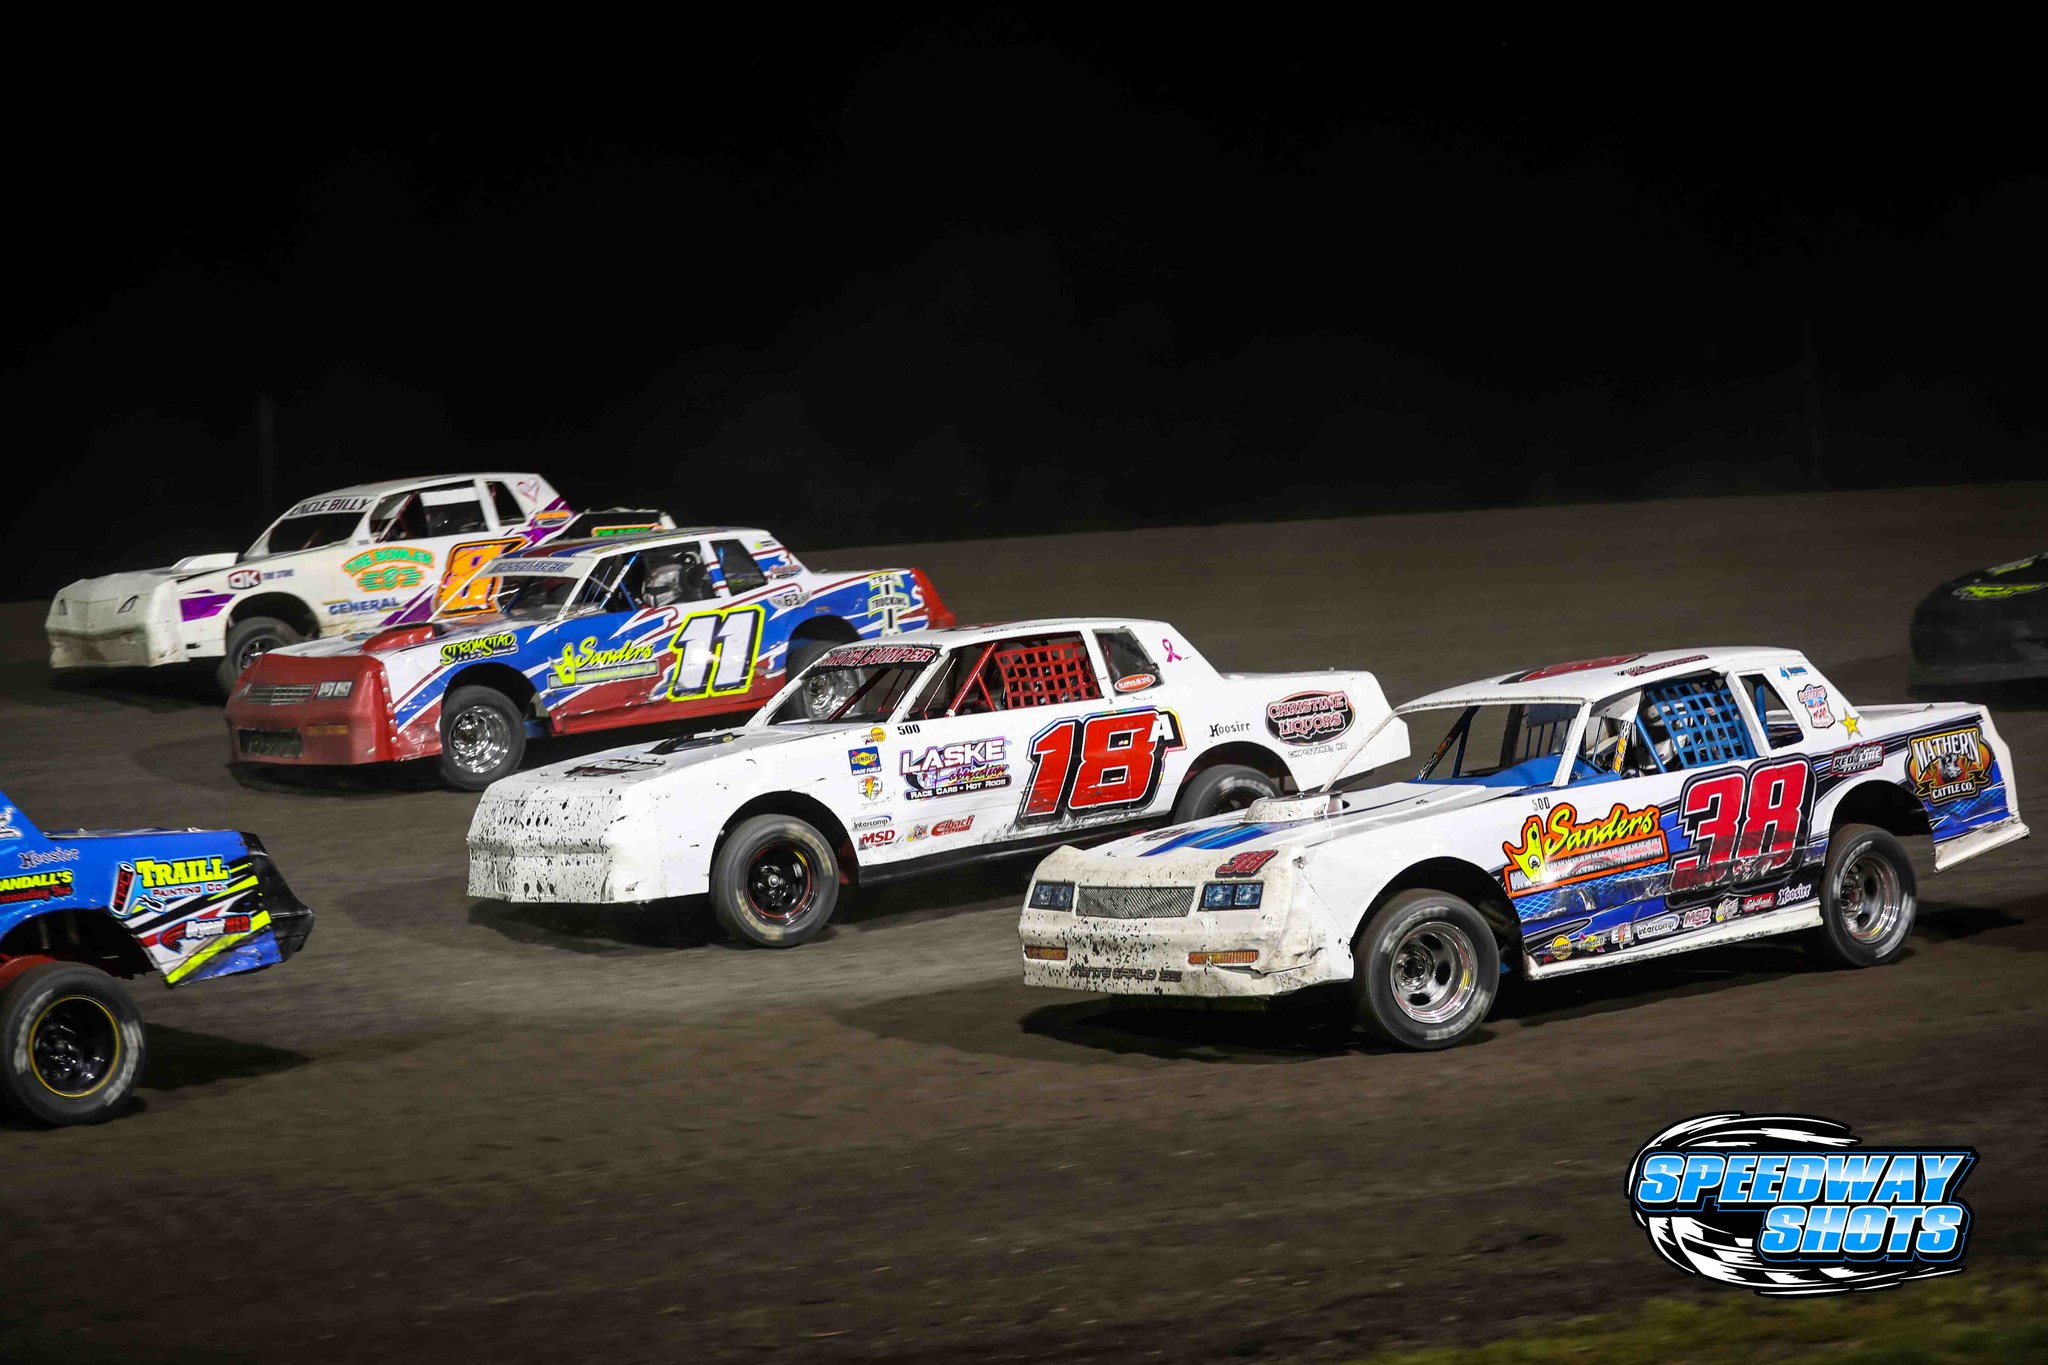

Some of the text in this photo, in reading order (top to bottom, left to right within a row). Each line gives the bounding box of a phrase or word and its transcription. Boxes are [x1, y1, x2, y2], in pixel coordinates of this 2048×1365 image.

[328, 499, 373, 511] BILLY
[344, 549, 433, 575] THE BOWLER
[330, 597, 400, 615] GENERAL
[441, 633, 516, 665] STROMSTAD
[575, 636, 653, 668] Sanders
[671, 606, 761, 699] 11
[856, 646, 936, 666] BUMPER
[1268, 695, 1346, 719] CHRISTINE
[897, 724, 921, 735] 500
[1280, 712, 1343, 737] LIQUORS
[852, 753, 877, 764] SUNOCO
[901, 739, 1005, 774] LASKE
[1913, 731, 1982, 779] MATHERN
[910, 779, 1006, 800] RACE CARS HOT RODS
[1932, 782, 1975, 799] CATTLE CO.
[1532, 797, 1551, 811] 500
[853, 818, 888, 829] Intercomp
[1544, 808, 1654, 855] Sanders
[1670, 761, 1808, 889] 38
[861, 830, 896, 844] MSD
[17, 846, 80, 869] Hoosier
[1216, 850, 1278, 877] 38
[135, 858, 229, 887] TRAILL
[153, 885, 202, 897] PAINTING
[1777, 883, 1811, 905] Hoosier
[1638, 920, 1675, 936] Intercomp
